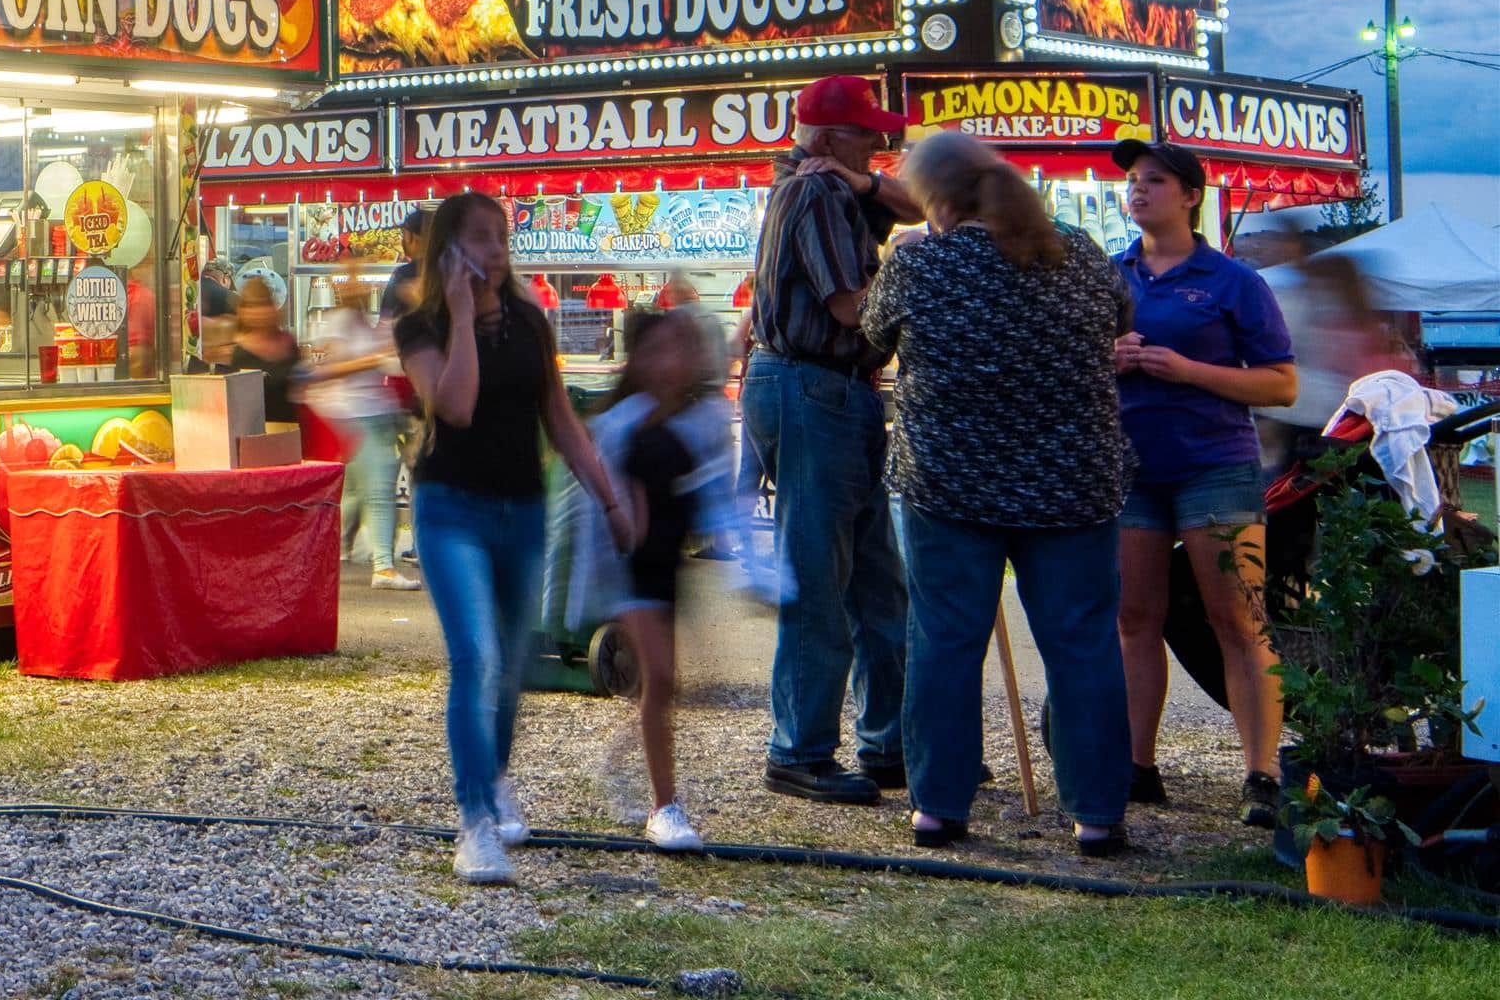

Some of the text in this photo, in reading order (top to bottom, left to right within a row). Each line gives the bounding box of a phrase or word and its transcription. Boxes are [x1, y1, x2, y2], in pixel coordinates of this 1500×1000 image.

[921, 79, 1140, 126] LEMONADE!
[415, 89, 802, 161] MEATBALL SU
[960, 115, 1102, 138] SHAKE-UPS
[1169, 88, 1349, 155] CALZONES
[203, 118, 372, 168] LZONES
[80, 214, 110, 233] ICED
[87, 233, 109, 248] TEA
[517, 232, 548, 251] COLD
[611, 233, 660, 251] SHAKE-UPS
[675, 230, 747, 251] ICE COLD
[76, 277, 117, 297] BOTTLED
[77, 303, 117, 323] WATER
